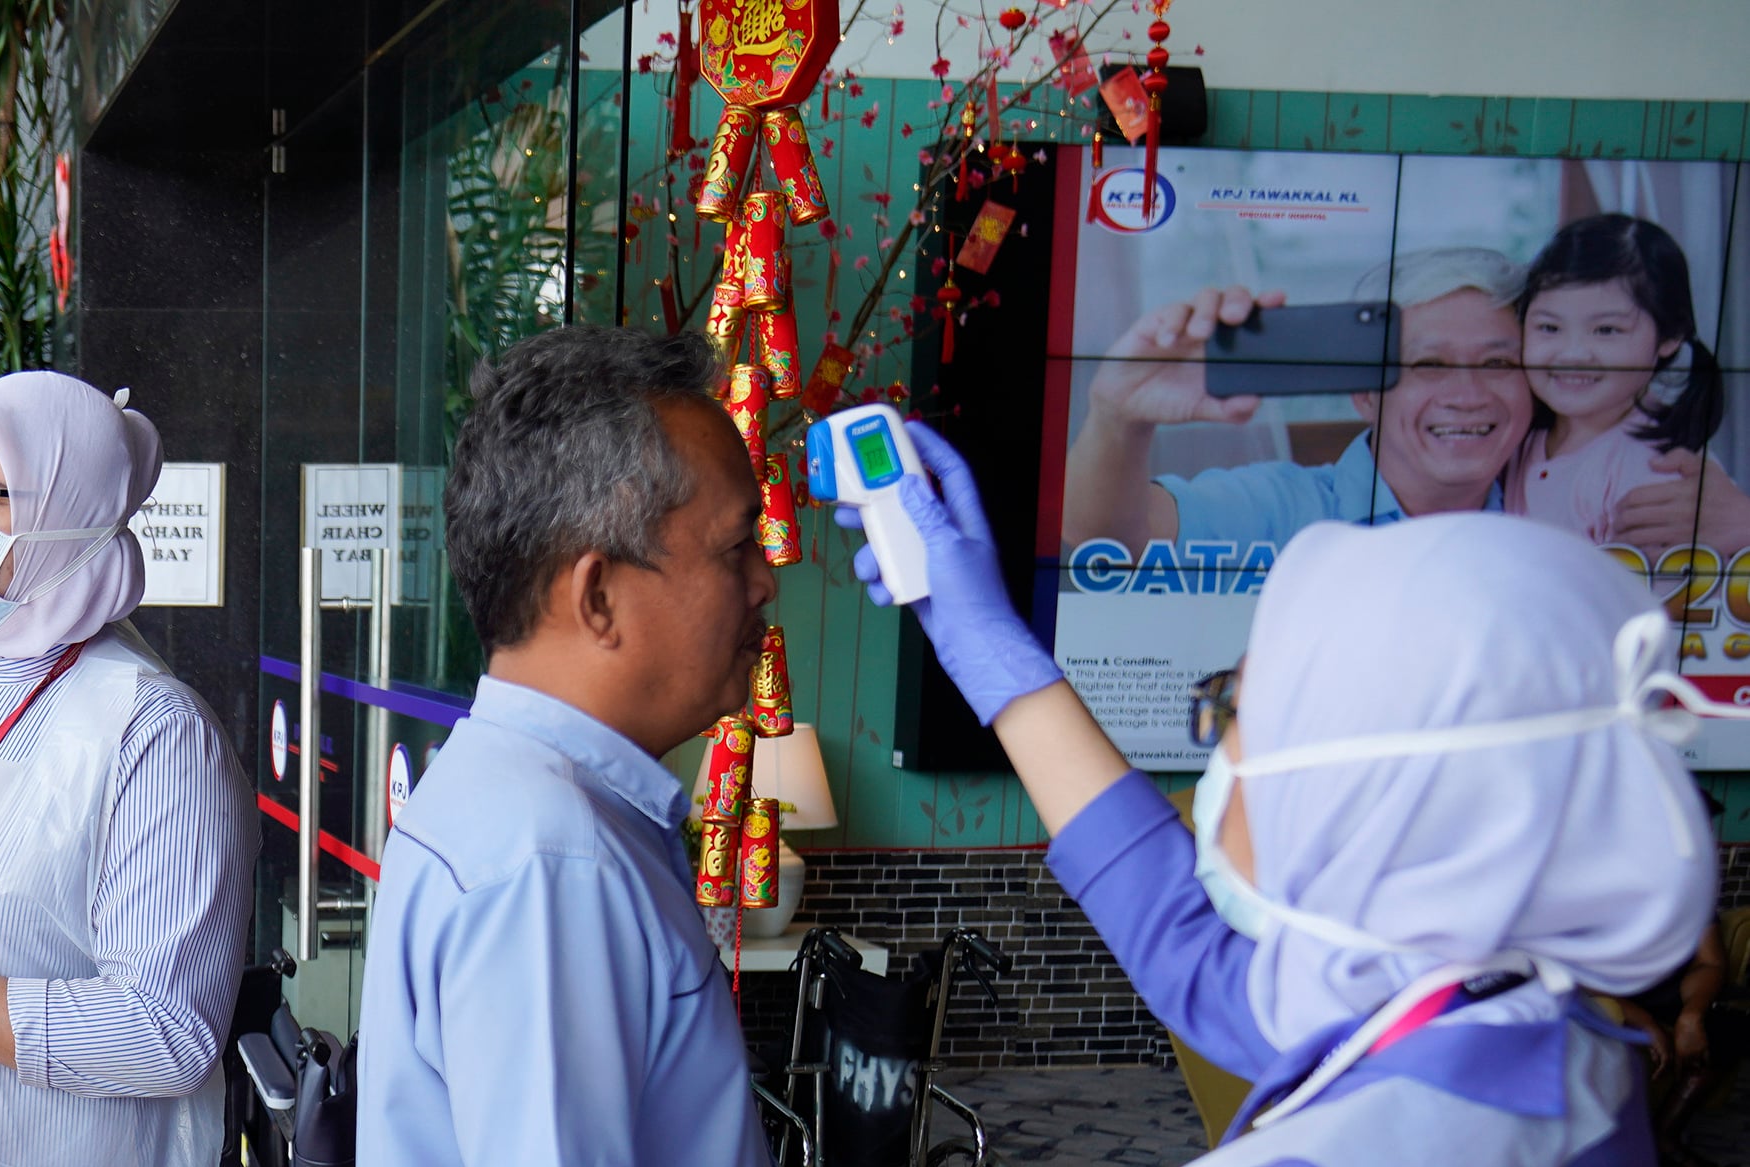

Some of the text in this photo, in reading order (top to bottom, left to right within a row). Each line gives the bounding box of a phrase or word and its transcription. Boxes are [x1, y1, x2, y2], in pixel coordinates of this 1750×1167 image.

[1250, 190, 1332, 202] TAWAKKAL
[142, 526, 204, 538] CHAIR
[152, 549, 192, 561] BAY
[1068, 537, 1278, 596] CATA
[1066, 657, 1098, 666] Terms
[1098, 670, 1151, 682] package
[1155, 670, 1184, 681] price
[1118, 681, 1131, 691] for
[1161, 682, 1182, 693] day
[1129, 694, 1170, 704] include
[1096, 706, 1149, 717] package
[391, 780, 407, 800] KPJ
